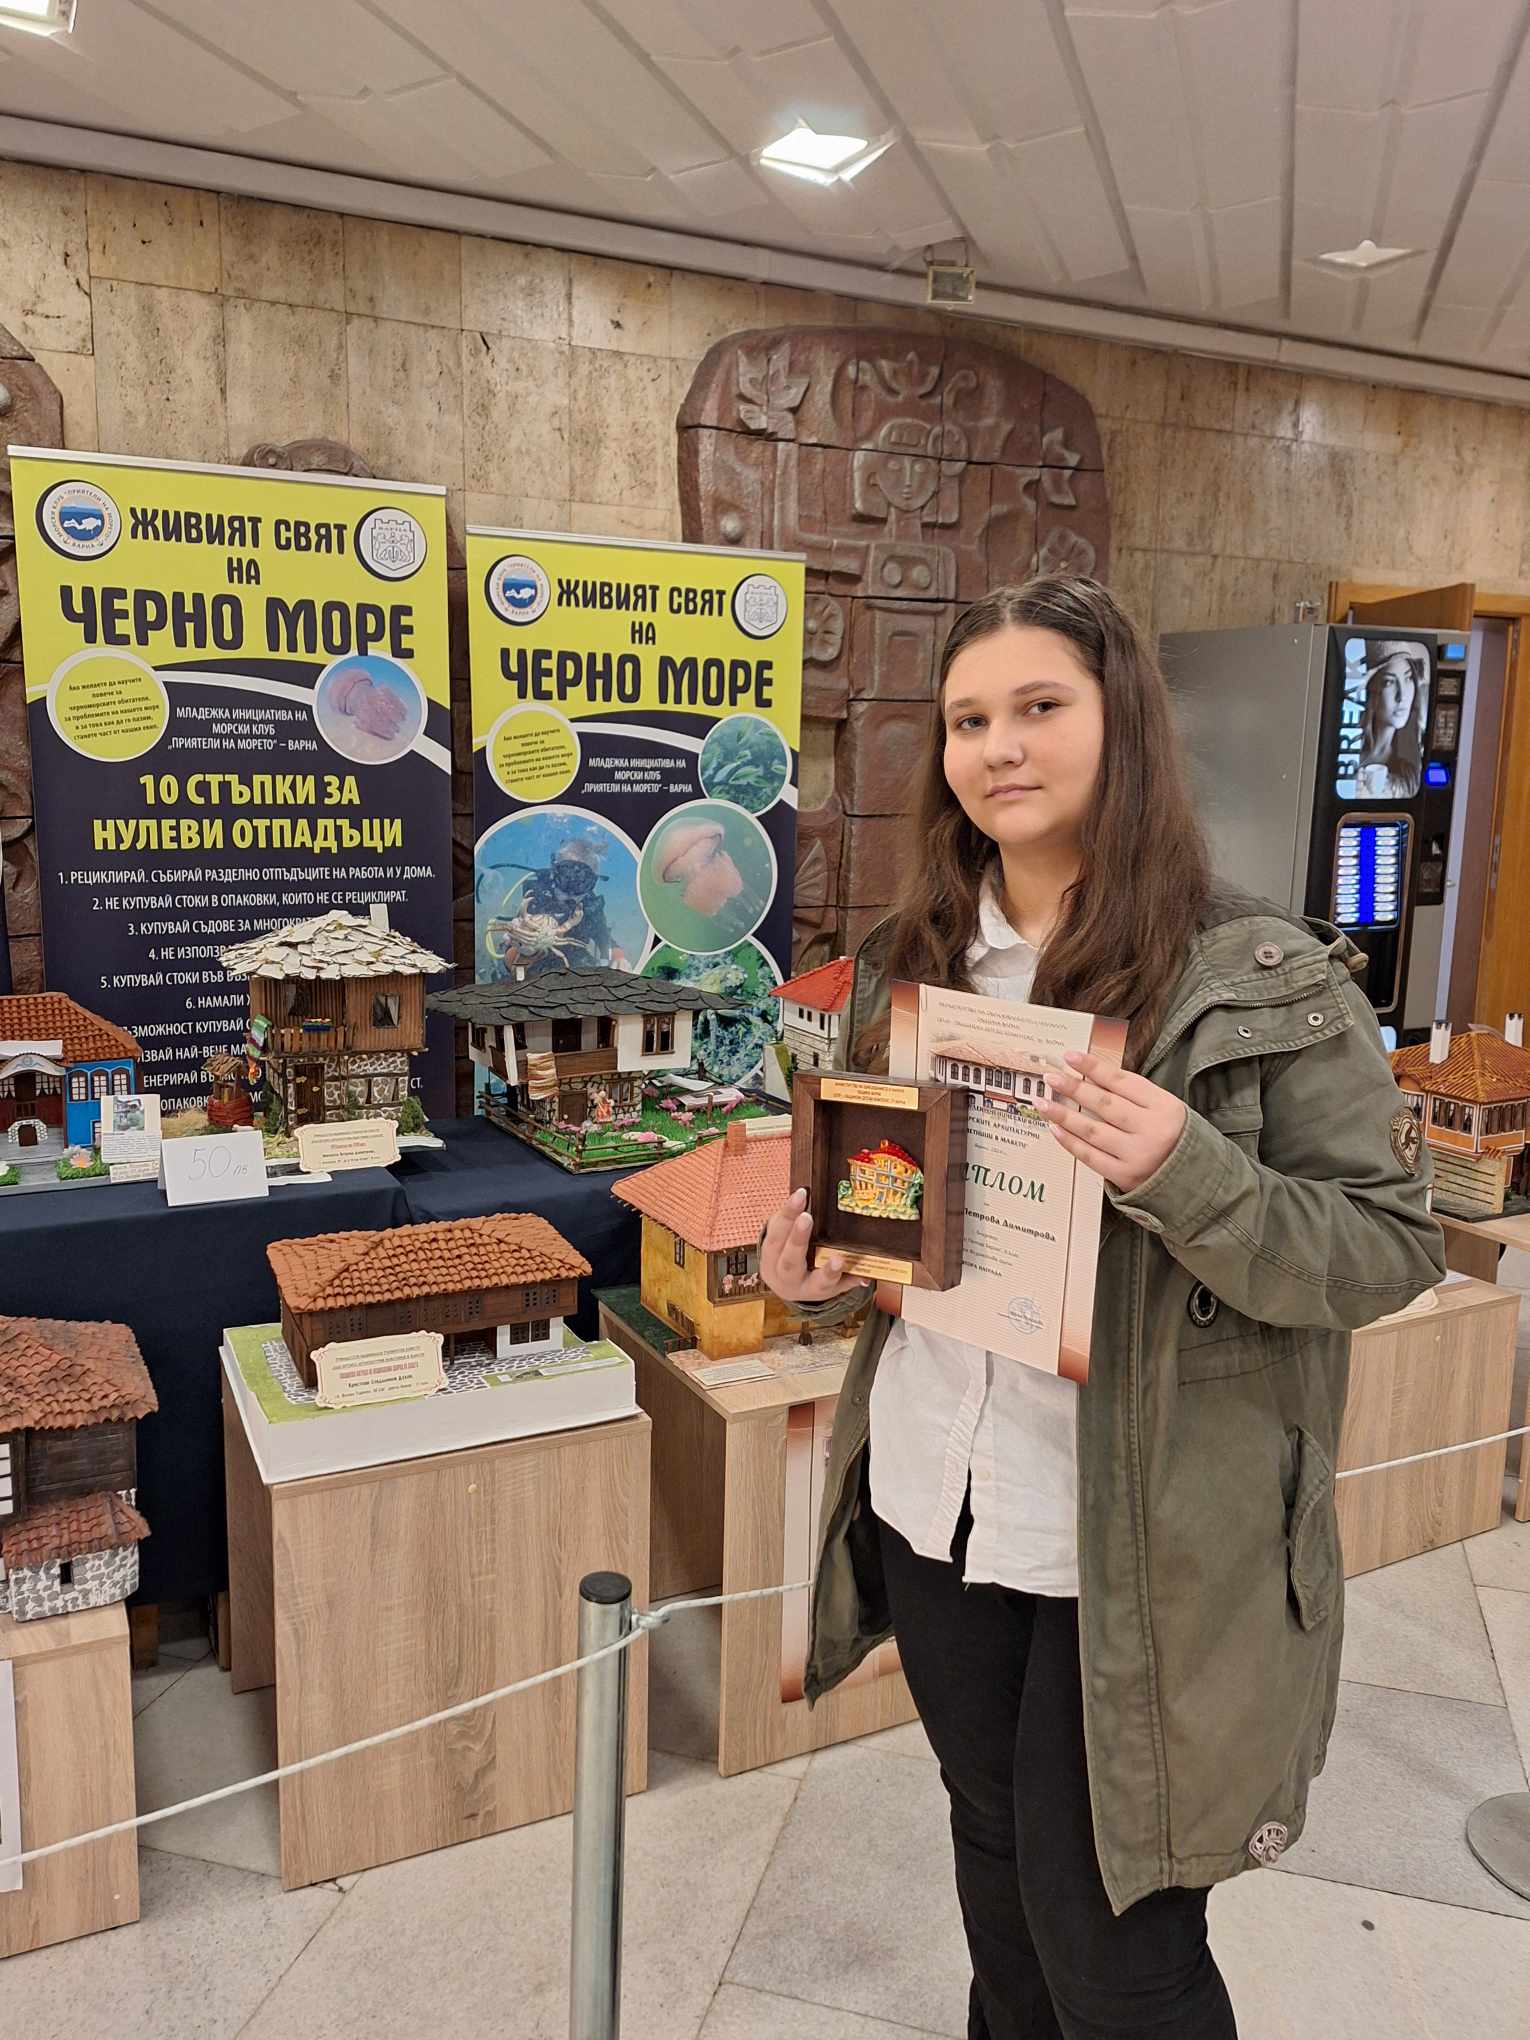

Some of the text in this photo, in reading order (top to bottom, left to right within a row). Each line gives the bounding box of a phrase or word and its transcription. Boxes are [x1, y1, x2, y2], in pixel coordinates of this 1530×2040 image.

[130, 507, 348, 555] ЖИВИЯТ СВЯТ
[227, 556, 261, 585] НА
[557, 578, 660, 613] ЖИВИЯТ
[669, 586, 727, 617] СВЯТ
[60, 585, 415, 659] ЧЕРНО МОРЕ
[630, 620, 656, 646] НА
[500, 647, 773, 708] ЧЕРНО МОРЕ
[176, 706, 307, 721] МЛАДЕЖКА ИНИЦИАТИВА НА
[212, 722, 276, 735] МОРСКИ КЛУБ
[222, 738, 235, 750] НА
[288, 739, 318, 751] ВАРНА
[588, 757, 686, 769] МЛАДЕЖКА ИНИЦИАТИВА НА
[614, 770, 662, 781] МОРСКИ КЛУБ
[139, 774, 361, 805] 10 СТЪПКИ ЗА
[621, 783, 631, 792] НА
[669, 783, 693, 793] ВАРНА
[93, 818, 402, 853] НУЛЕВИ ОТПАДЪЦИ
[58, 865, 435, 886] 1. РЕЦИКЛИРАЙ. СЪБИРАЙ РАЗДЕЛНО ОТПЪДЪЦИТЕ НА РАБОТА И У ДОМА.
[93, 889, 408, 911] 2. НЕ КУПУВАЙ СТОКИ В ОПАКОВКИ, КОИТО НЕ СЕ РЕЦИКЛИРАТ.
[128, 923, 138, 936] 3.
[140, 920, 190, 935] КУПУВАЙ
[192, 919, 235, 934] СЪДОВЕ
[237, 919, 251, 931] ЗА
[148, 948, 158, 960] 4.
[161, 947, 175, 960] НЕ
[100, 975, 111, 989] 5.
[113, 972, 163, 988] КУПУВАЙ
[165, 972, 200, 986] СТОКИ
[202, 970, 224, 984] ВЪВ
[186, 996, 196, 1010] 6.
[198, 994, 244, 1009] НАМАЛИ
[196, 1017, 244, 1033] КУПУВАЙ
[144, 1070, 198, 1088] ЕНЕРИРАЙ
[188, 1145, 232, 1181] 50
[1002, 1218, 1057, 1243] Димитрова
